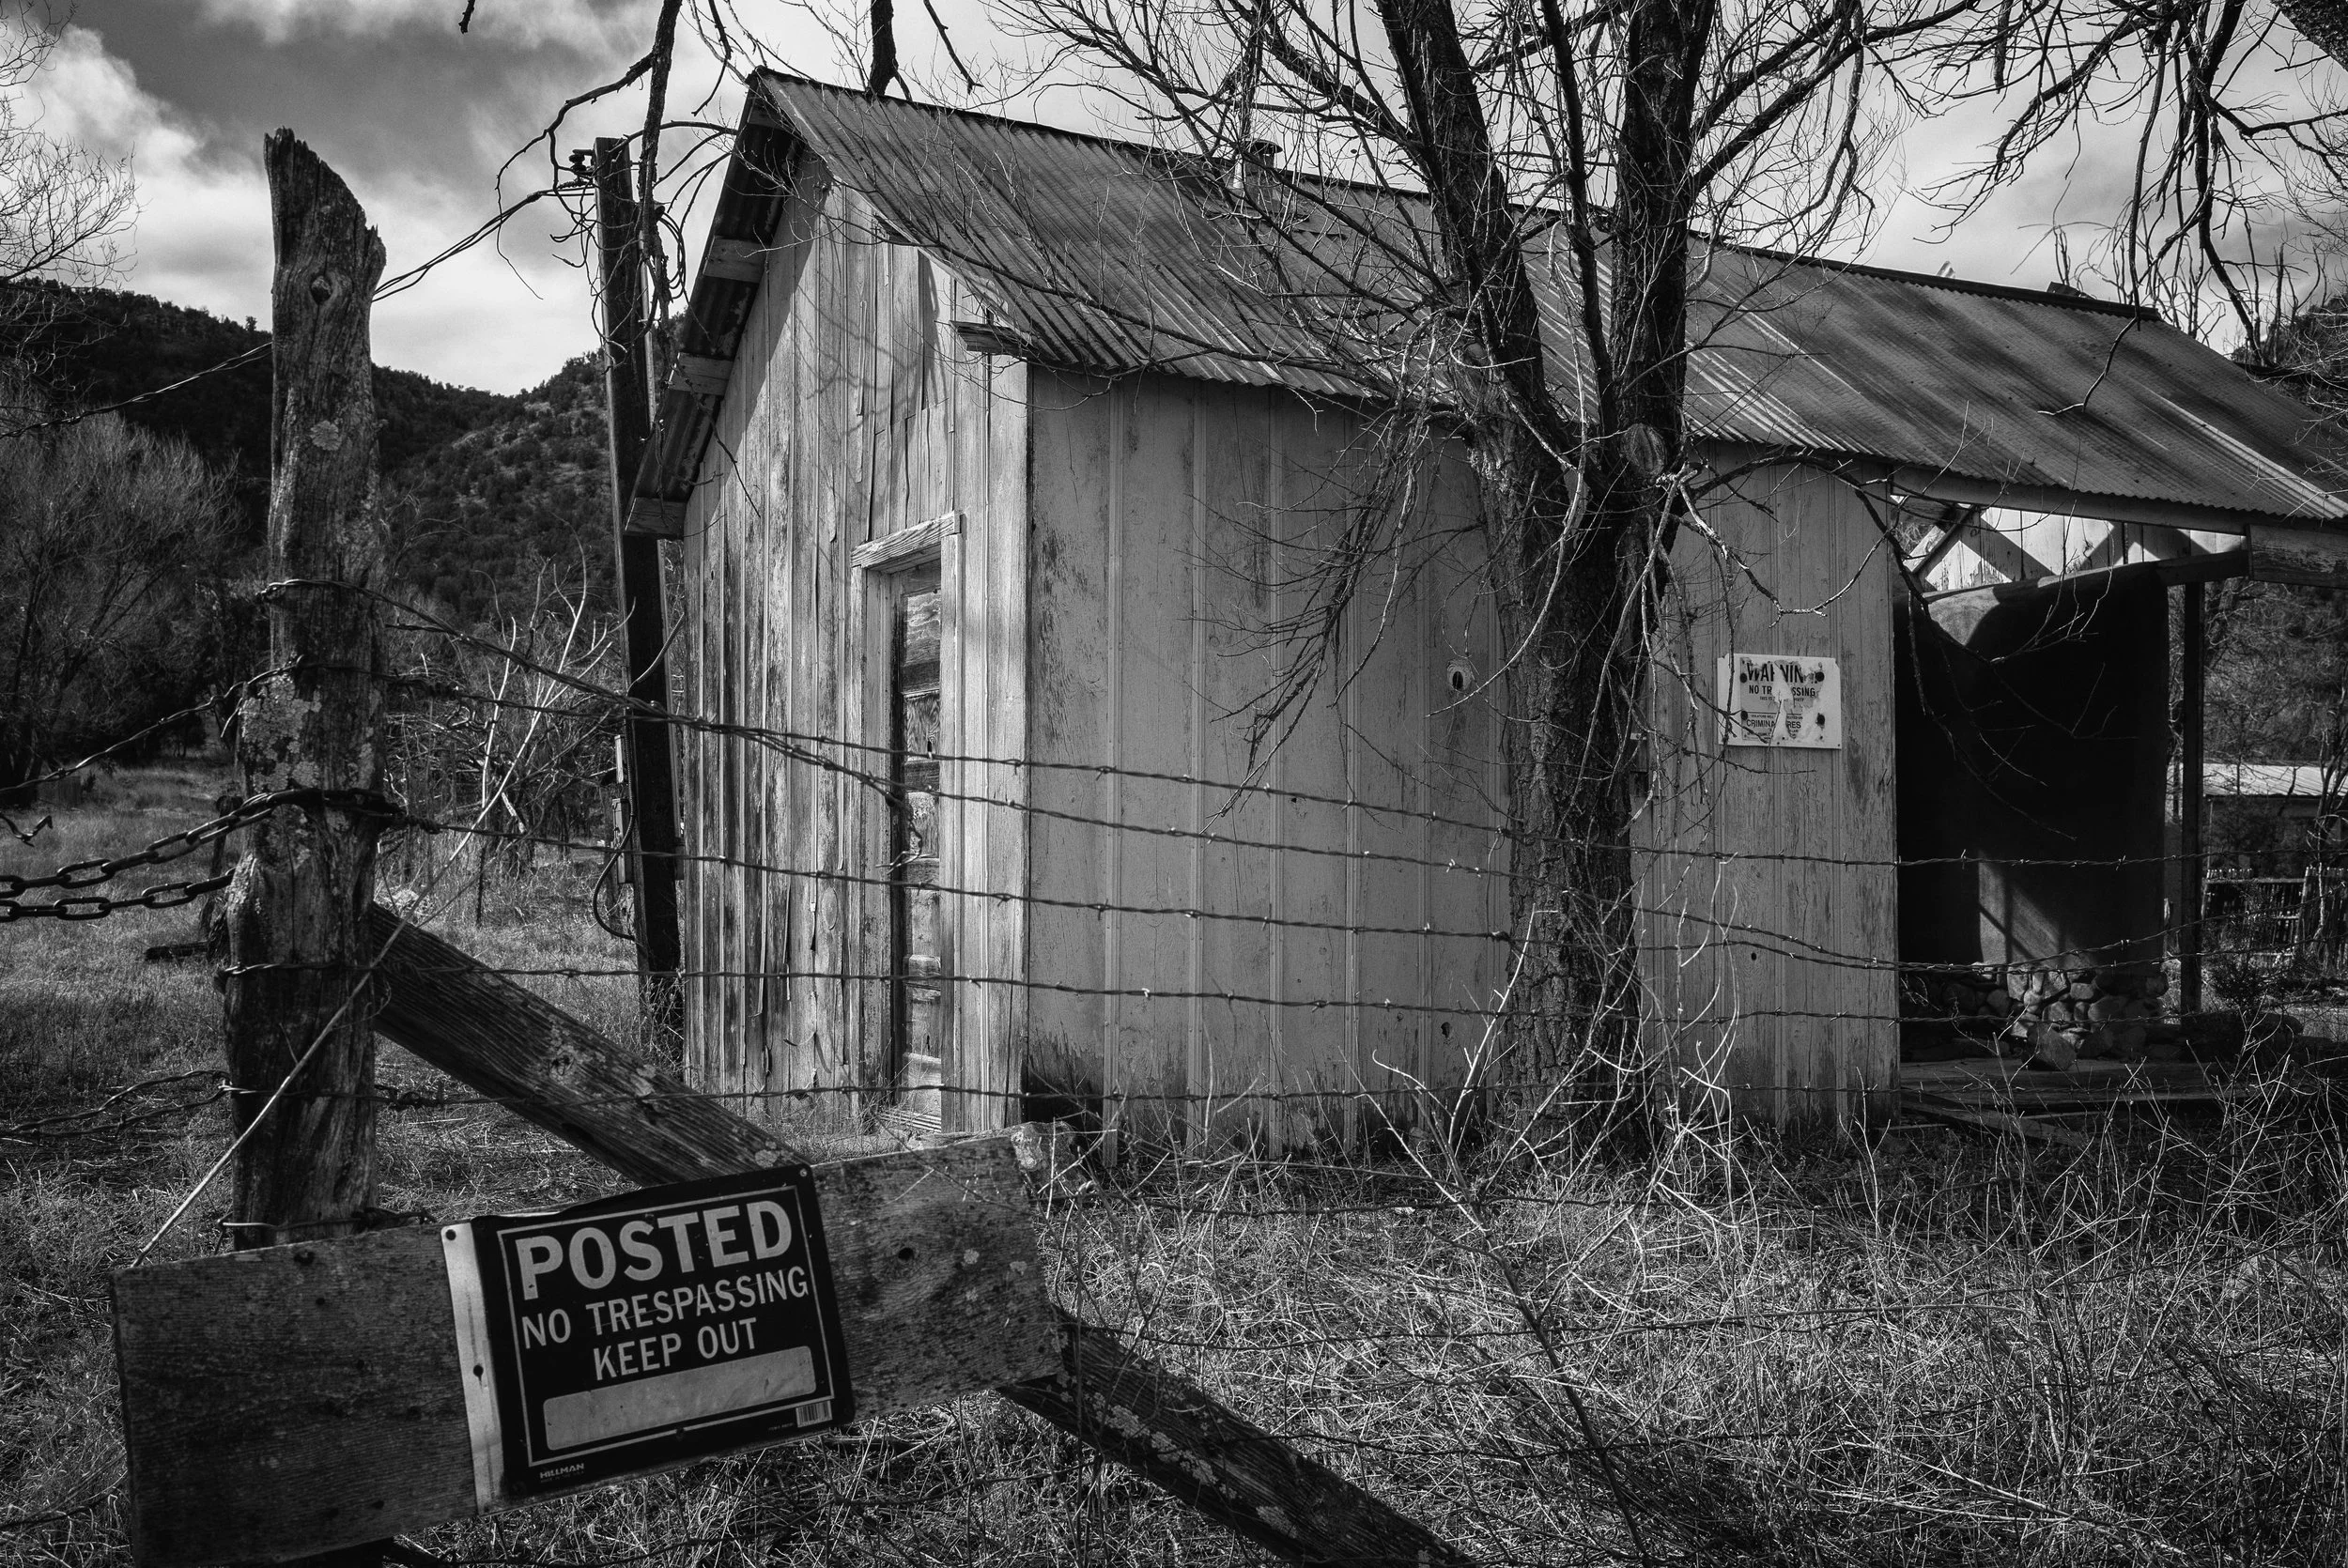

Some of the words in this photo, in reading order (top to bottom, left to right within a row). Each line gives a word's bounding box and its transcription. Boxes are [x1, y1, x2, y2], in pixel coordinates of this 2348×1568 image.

[1749, 684, 1759, 695] NO
[1762, 685, 1815, 697] TRSSING
[1746, 719, 1776, 728] CRIMINA
[515, 1200, 793, 1300] POSTED
[521, 1308, 571, 1349] NO
[585, 1266, 809, 1336] TRESPASSING
[593, 1332, 681, 1381] KEEP
[697, 1316, 757, 1360] OUT
[539, 1462, 585, 1480] HILLMAN
